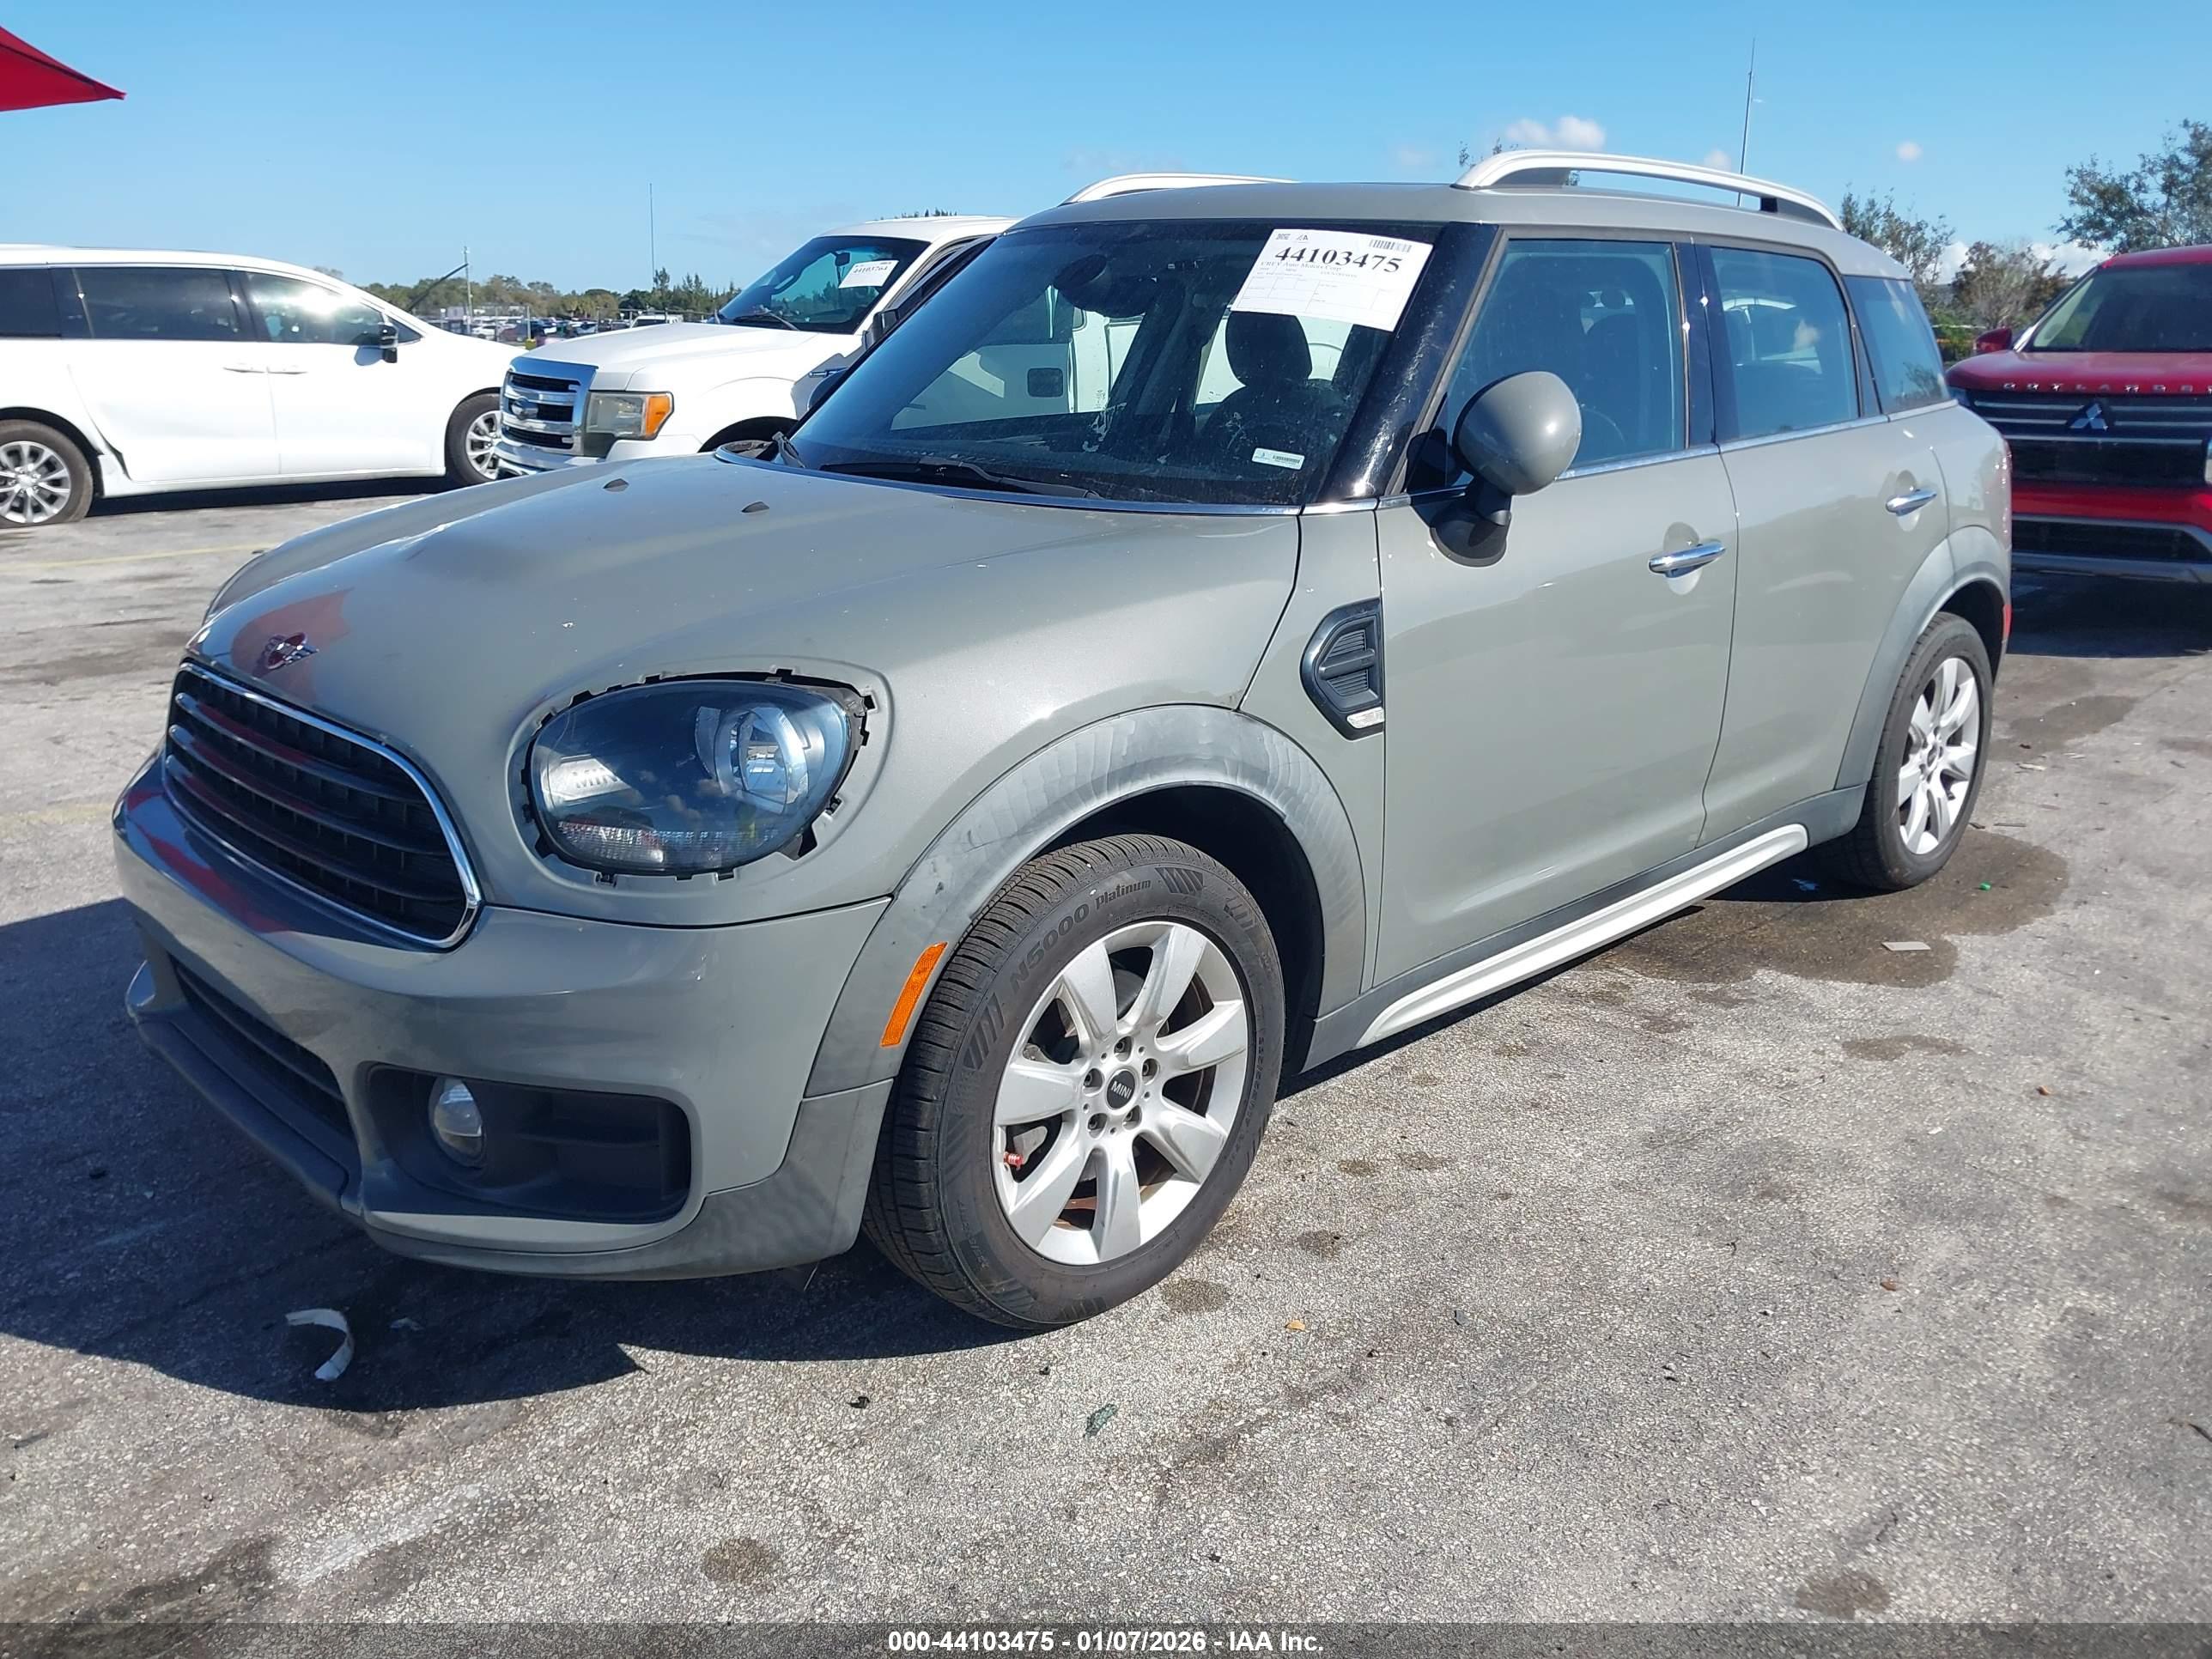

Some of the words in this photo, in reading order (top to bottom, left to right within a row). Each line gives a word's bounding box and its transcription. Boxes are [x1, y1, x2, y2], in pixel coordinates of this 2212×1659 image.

[1274, 246, 1402, 272] 44103475
[1010, 903, 1089, 992] N5000
[1111, 1080, 1132, 1099] MINI
